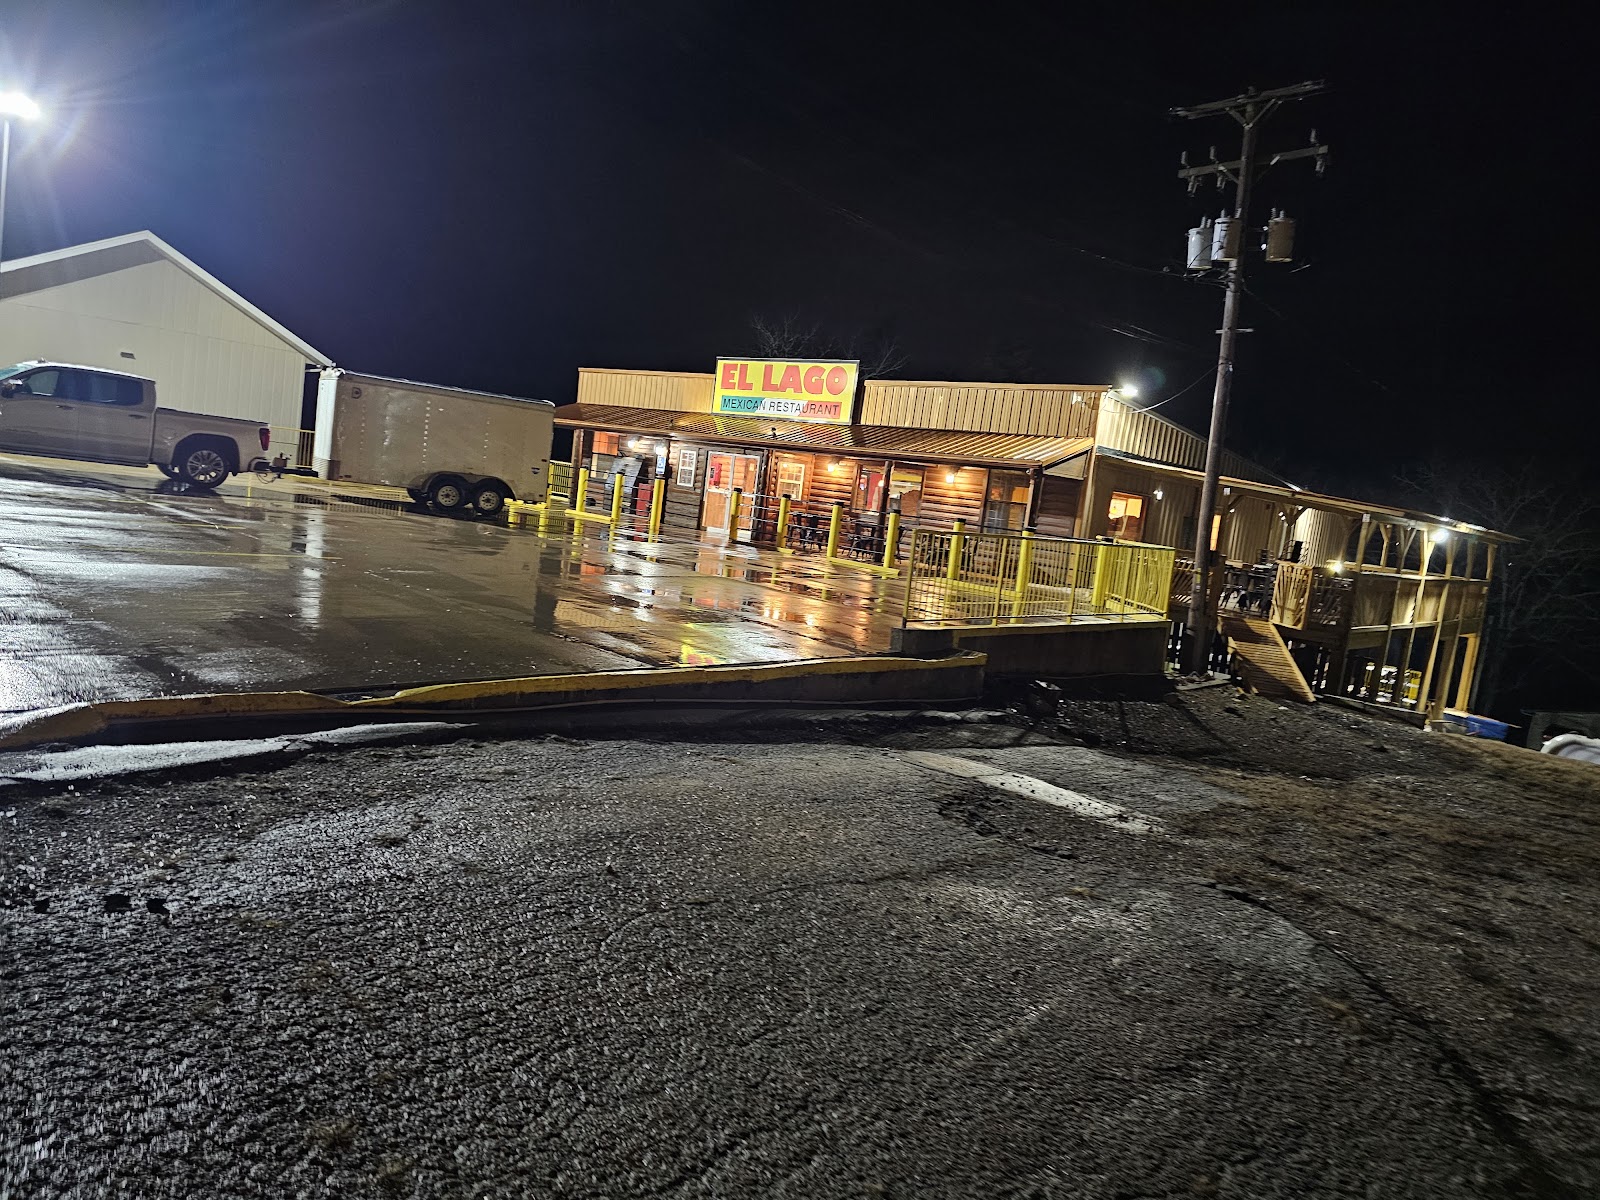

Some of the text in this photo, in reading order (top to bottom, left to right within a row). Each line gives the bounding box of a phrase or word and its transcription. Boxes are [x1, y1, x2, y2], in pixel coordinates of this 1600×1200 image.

[721, 363, 848, 395] EL LAGO
[722, 398, 839, 415] MEXICAN RESTAURANT
